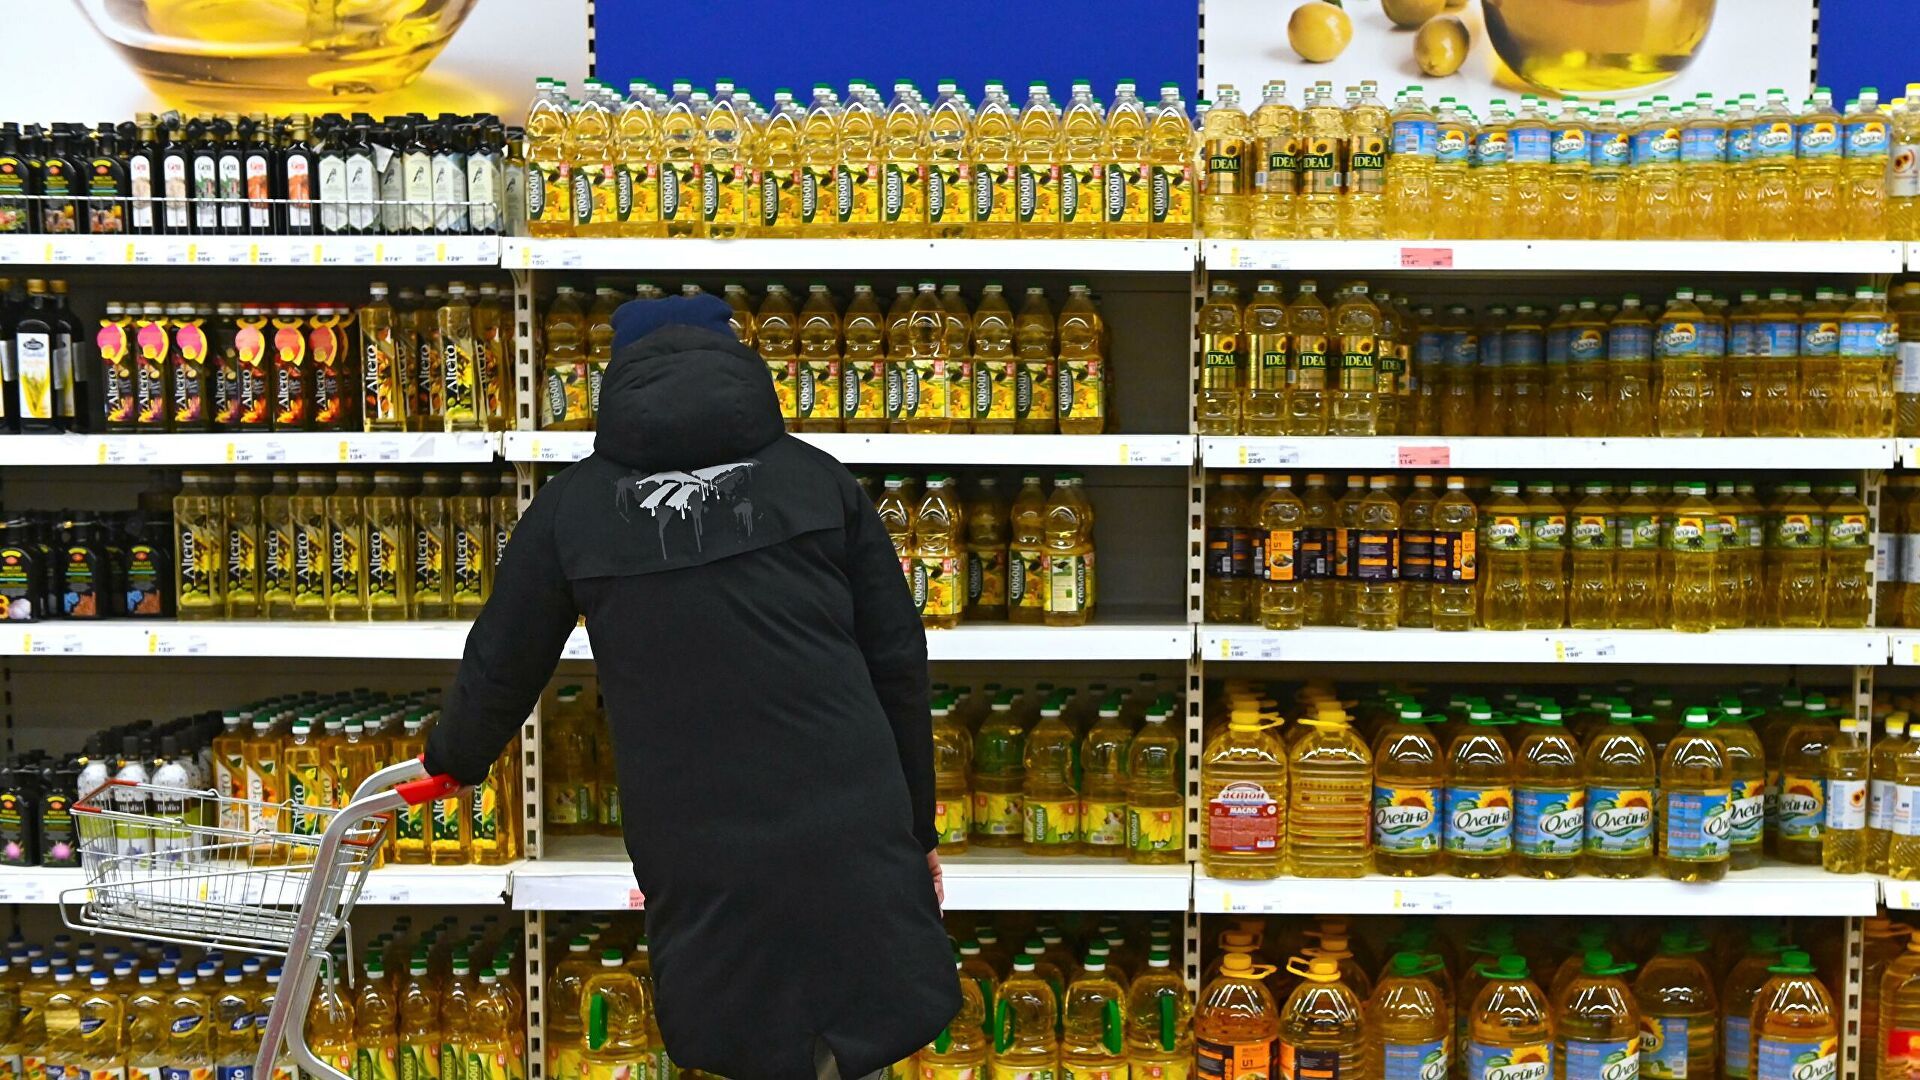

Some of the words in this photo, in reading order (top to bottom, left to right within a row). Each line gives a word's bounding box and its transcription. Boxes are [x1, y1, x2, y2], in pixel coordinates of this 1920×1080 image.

[1210, 158, 1239, 170] IDEAL
[1272, 156, 1296, 168] IDEA
[1354, 156, 1383, 168] IDEAL
[365, 344, 378, 394] Altero
[446, 344, 458, 393] Altero
[1207, 354, 1235, 365] IDEAL
[1266, 354, 1286, 365] IDEA
[1345, 355, 1373, 366] IDEAL
[181, 531, 195, 579] Altero
[228, 530, 240, 579] Altero
[266, 530, 278, 579] Altero
[296, 533, 309, 580] Altero
[331, 532, 344, 580] Altero
[370, 532, 382, 580] Altero
[416, 531, 428, 578] Altero
[456, 532, 468, 578] Altero
[1375, 809, 1429, 826] Олейна
[1456, 809, 1510, 829] Олейна
[1545, 812, 1584, 832] Олей
[1595, 809, 1650, 828] Олейна
